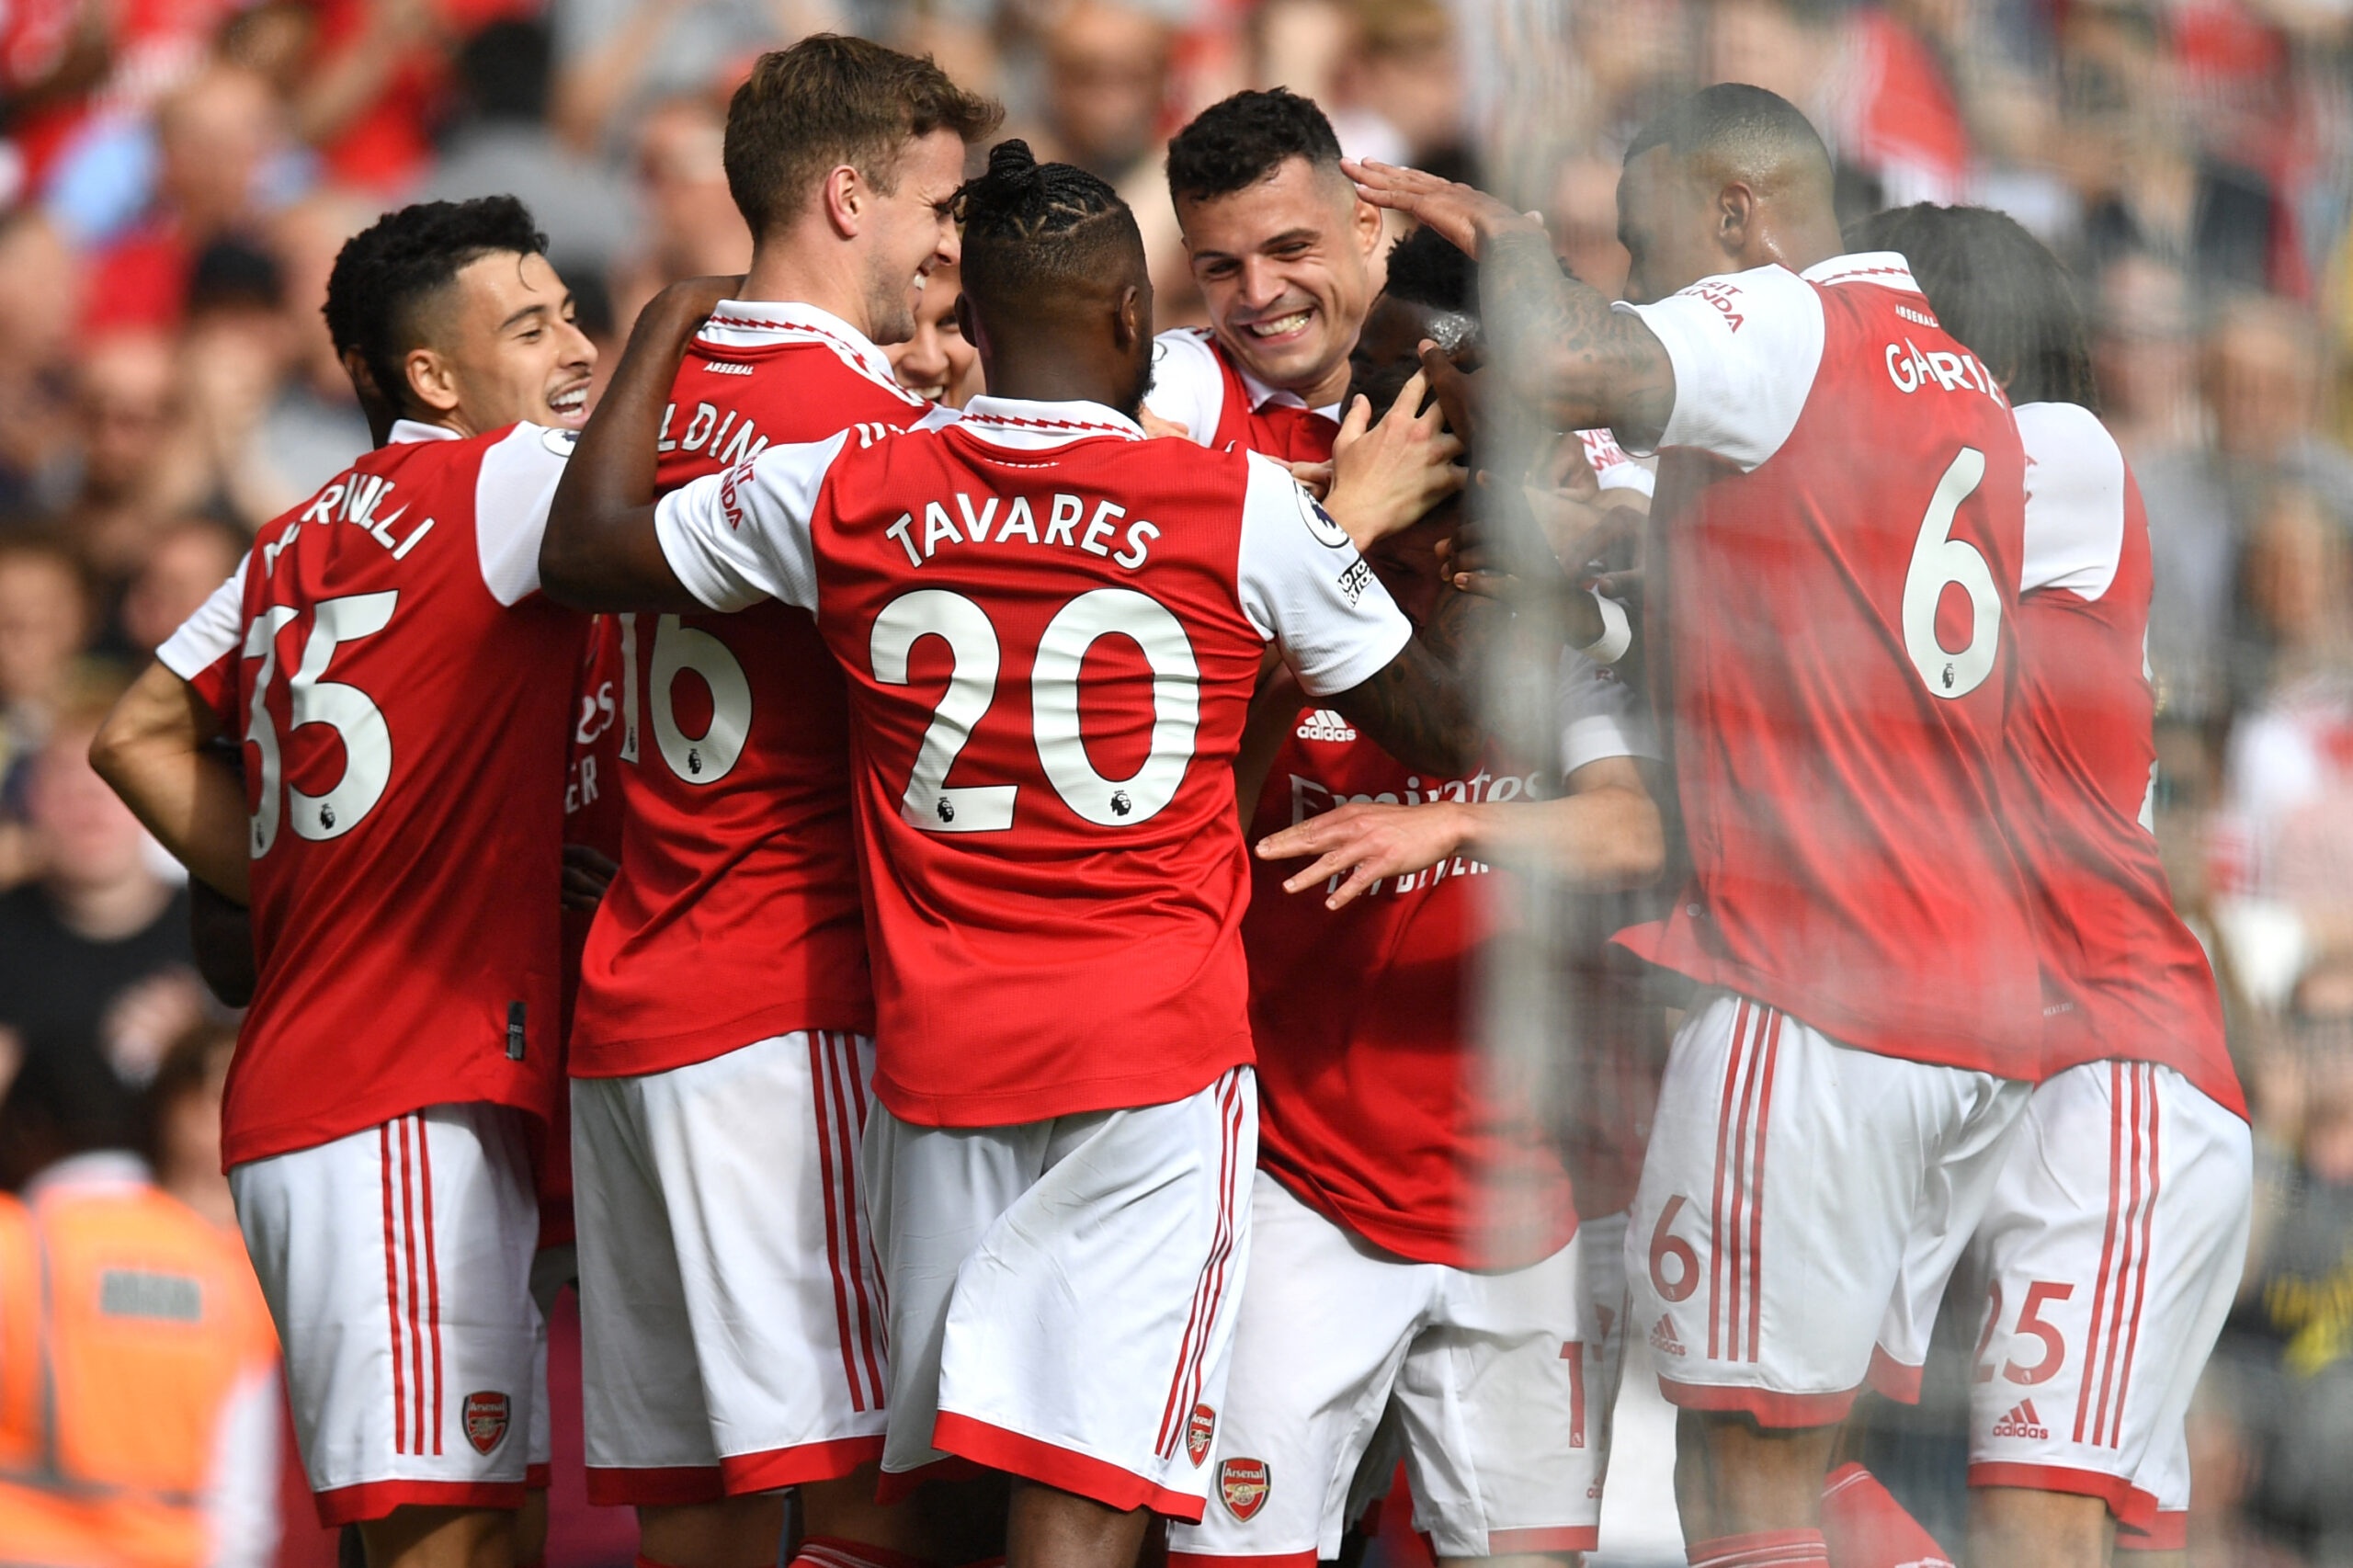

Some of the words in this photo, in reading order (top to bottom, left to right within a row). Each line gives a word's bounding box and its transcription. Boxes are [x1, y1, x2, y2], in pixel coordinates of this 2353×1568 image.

[1895, 304, 1939, 327] ARSENAL
[703, 361, 754, 376] ARSENAL
[658, 402, 769, 469] LDIN
[885, 493, 1161, 570] TAVARES
[1902, 446, 2002, 699] 6
[241, 588, 400, 860] 35
[618, 612, 753, 785] 16
[869, 587, 1201, 832] 20
[1297, 724, 1357, 742] adidas
[1648, 1195, 1699, 1302] 6
[1969, 1278, 2075, 1386] 25
[1993, 1421, 2049, 1440] adidas
[1225, 1468, 1264, 1479] Arsenal
